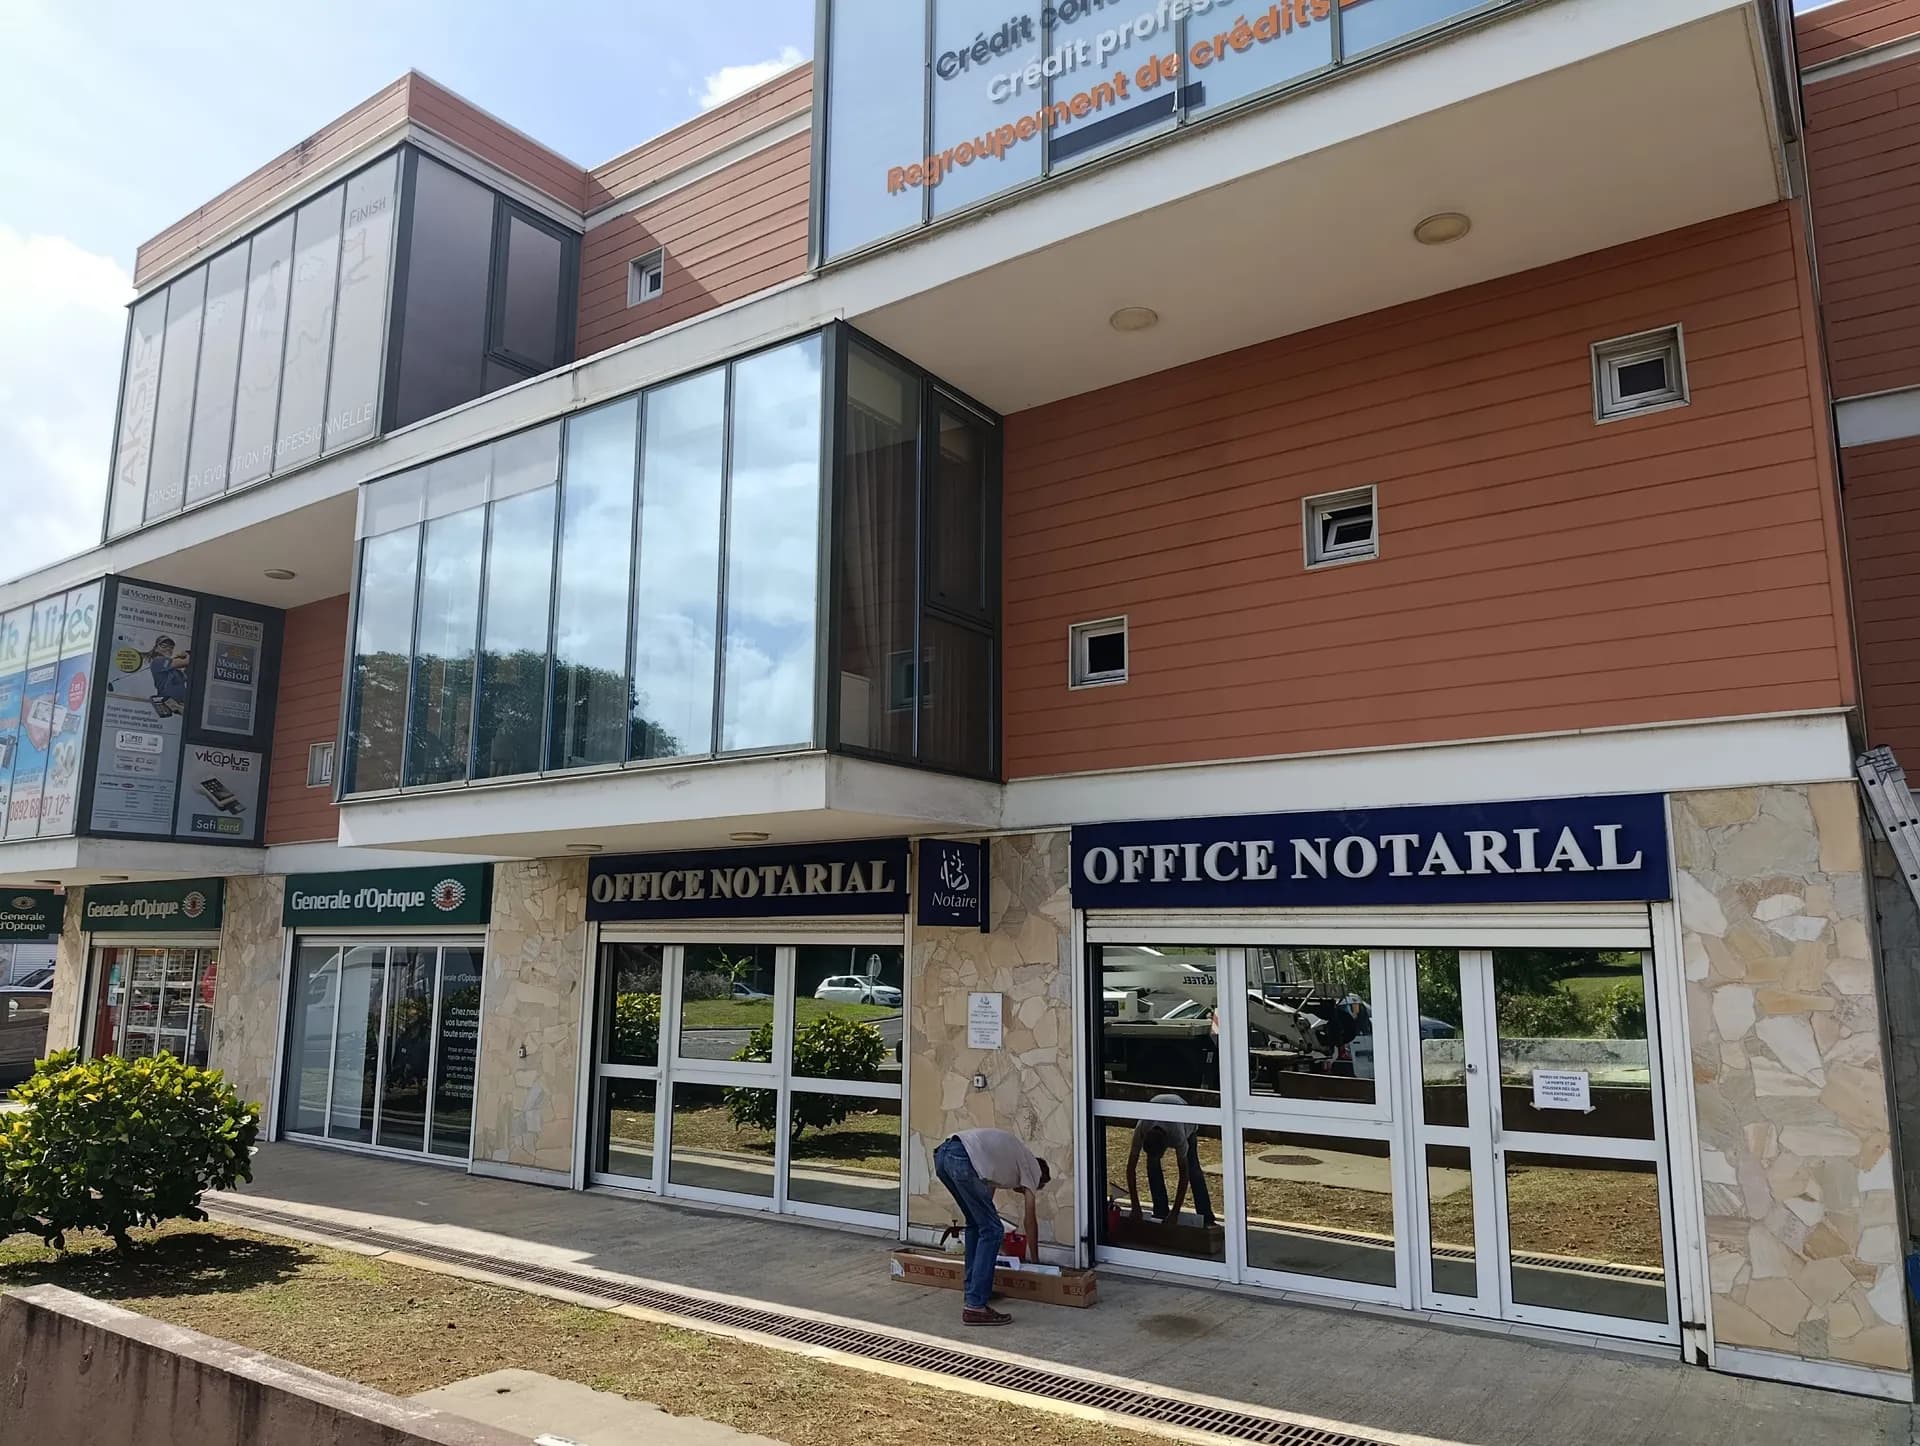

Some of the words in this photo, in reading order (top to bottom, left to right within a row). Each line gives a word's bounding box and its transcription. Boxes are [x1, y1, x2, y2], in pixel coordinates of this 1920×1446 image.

[936, 15, 1034, 79] Crédit
[987, 39, 1091, 103] Crédit
[887, 71, 1129, 195] Regroupement
[1135, 54, 1182, 90] de
[1190, 0, 1331, 67] crédits
[216, 668, 250, 681] Vision
[1083, 840, 1278, 885] OFFICE
[1289, 824, 1643, 879] NOTARIAL
[591, 869, 706, 903] OFFICE
[710, 860, 896, 898] NOTARIAL
[0, 911, 45, 920] Generale
[87, 900, 129, 918] Generale
[130, 899, 179, 919] d'Optique
[291, 889, 350, 911] Generale
[354, 887, 425, 913] d'Optique
[931, 891, 977, 909] Notaire
